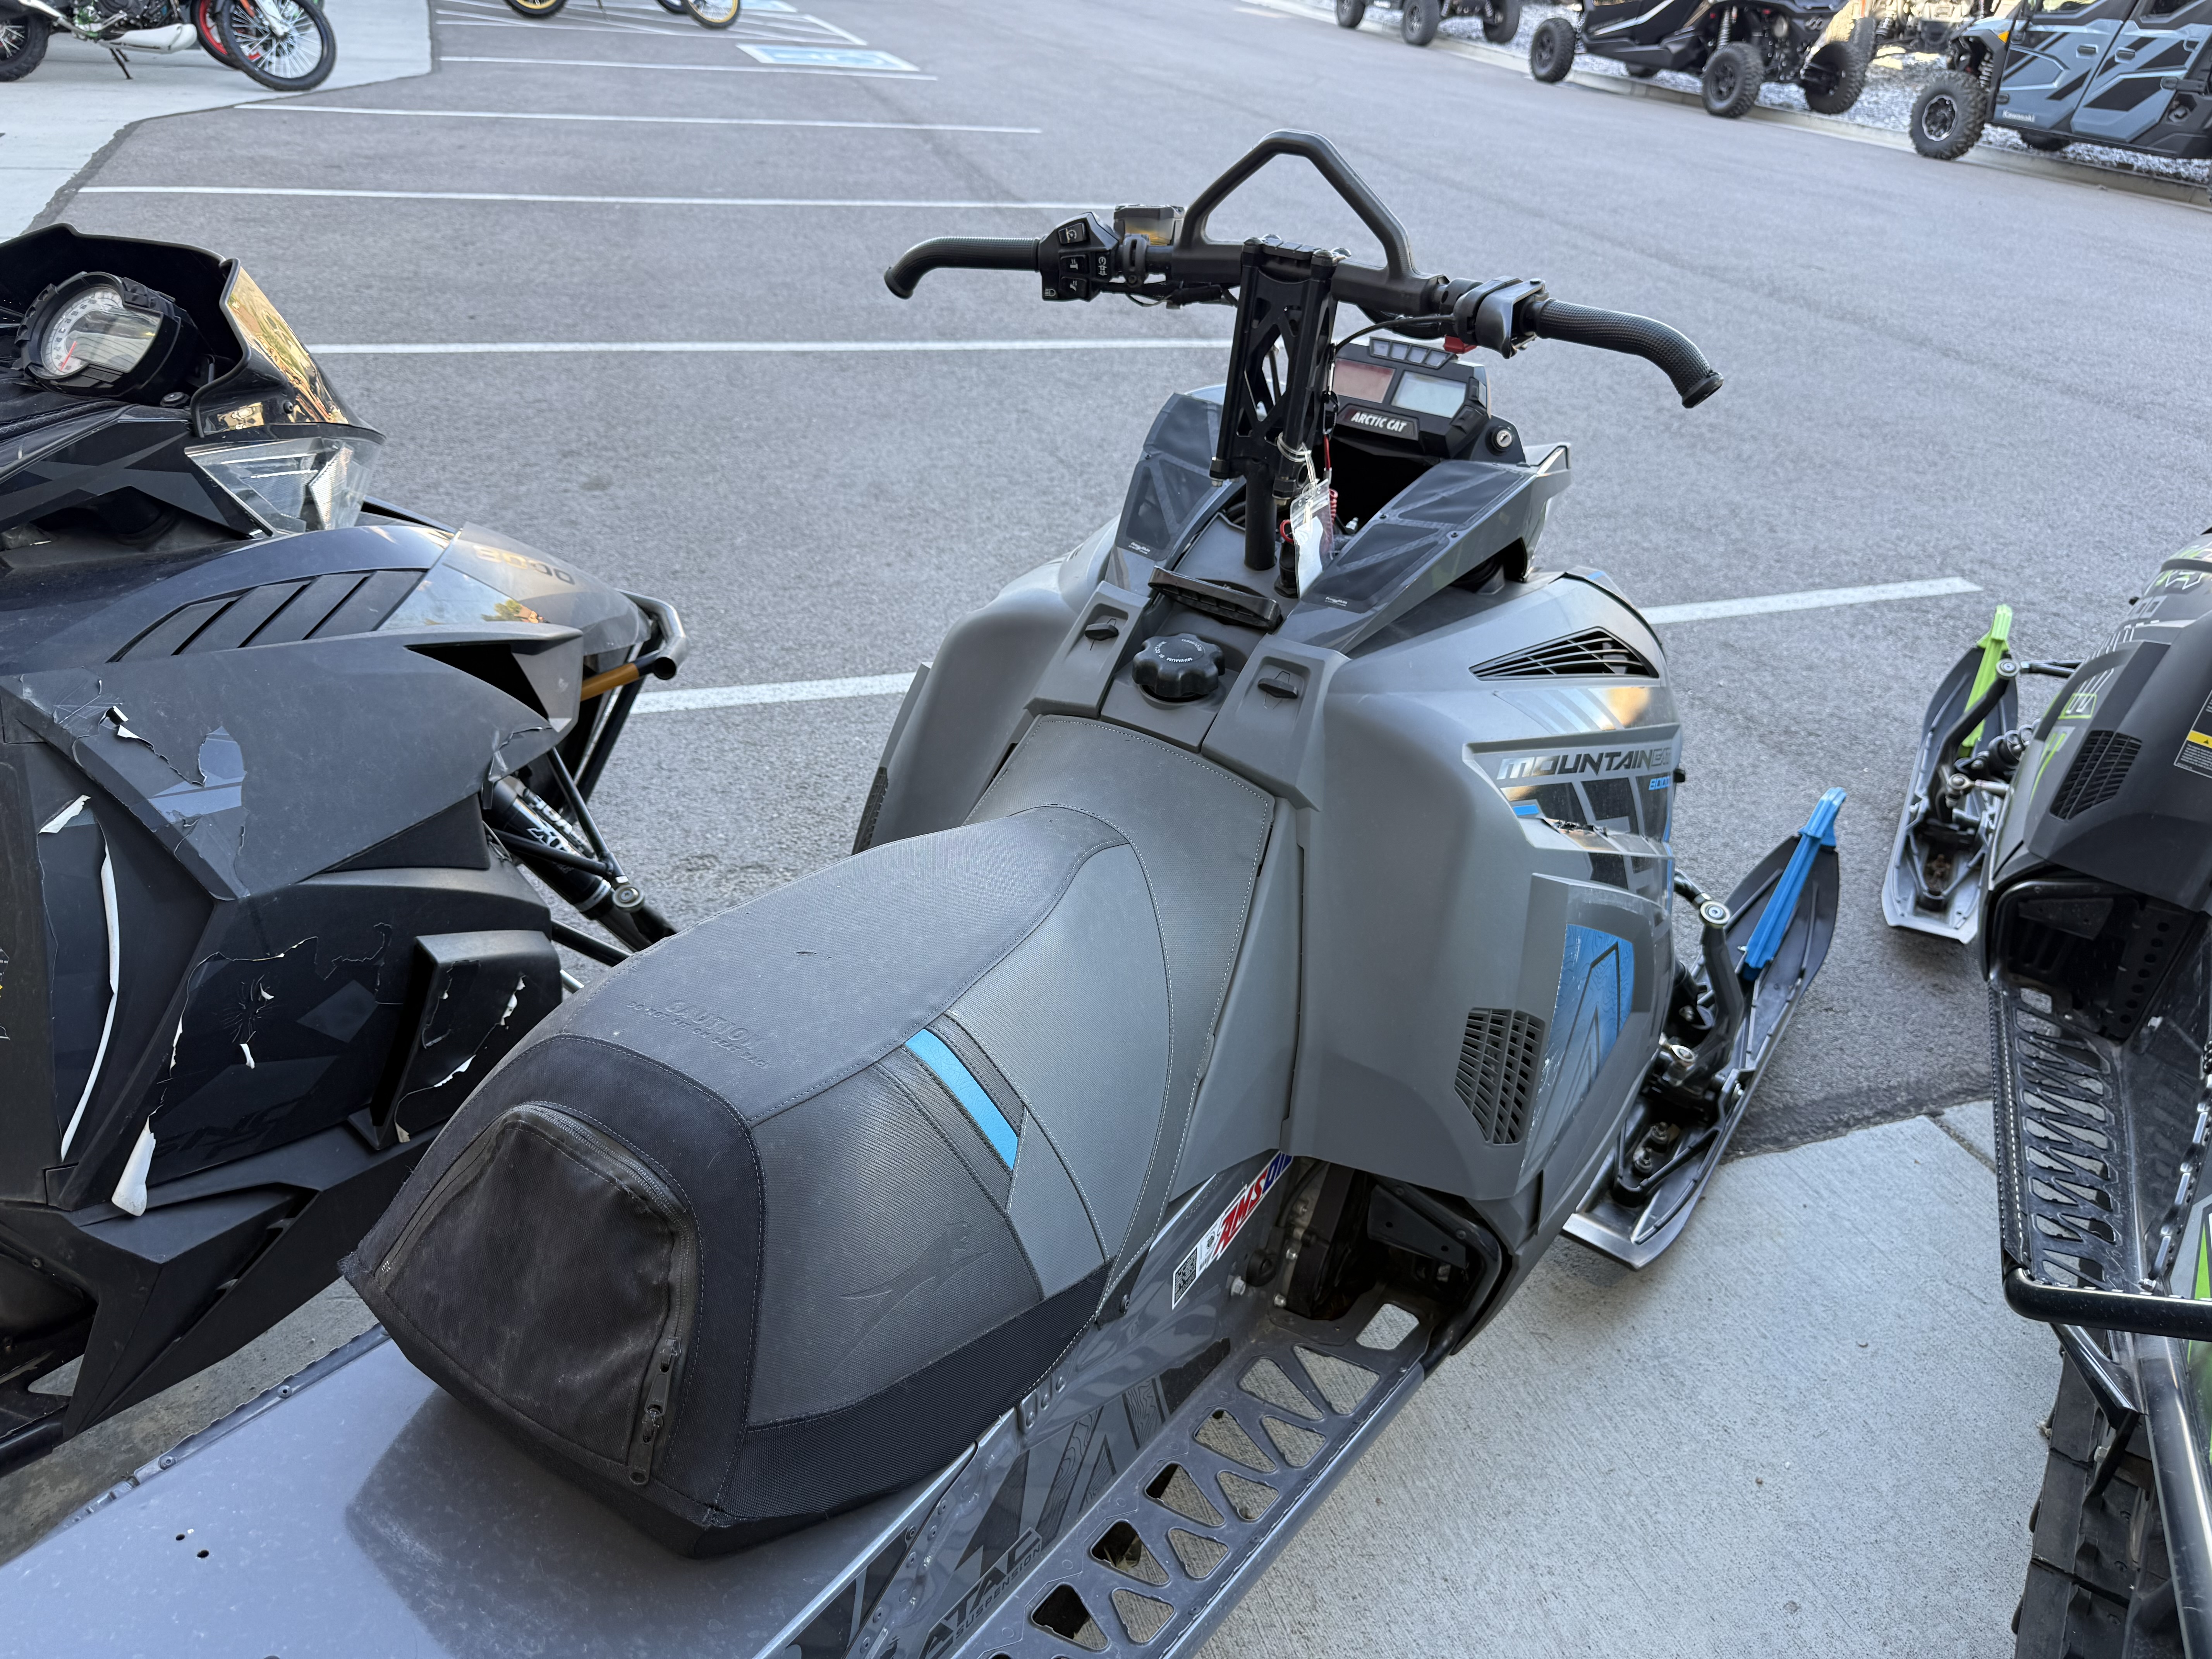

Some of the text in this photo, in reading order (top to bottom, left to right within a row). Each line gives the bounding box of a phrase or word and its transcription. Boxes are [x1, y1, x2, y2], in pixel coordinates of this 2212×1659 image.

[2002, 110, 2035, 123] Kawasaki
[1351, 411, 1407, 432] ARCTIC CAT
[473, 545, 575, 585] 8000
[626, 1001, 645, 1010] DO
[671, 1019, 691, 1029] SIT
[665, 1000, 764, 1049] CAUTION
[956, 1544, 1041, 1639] SUSPENSION
